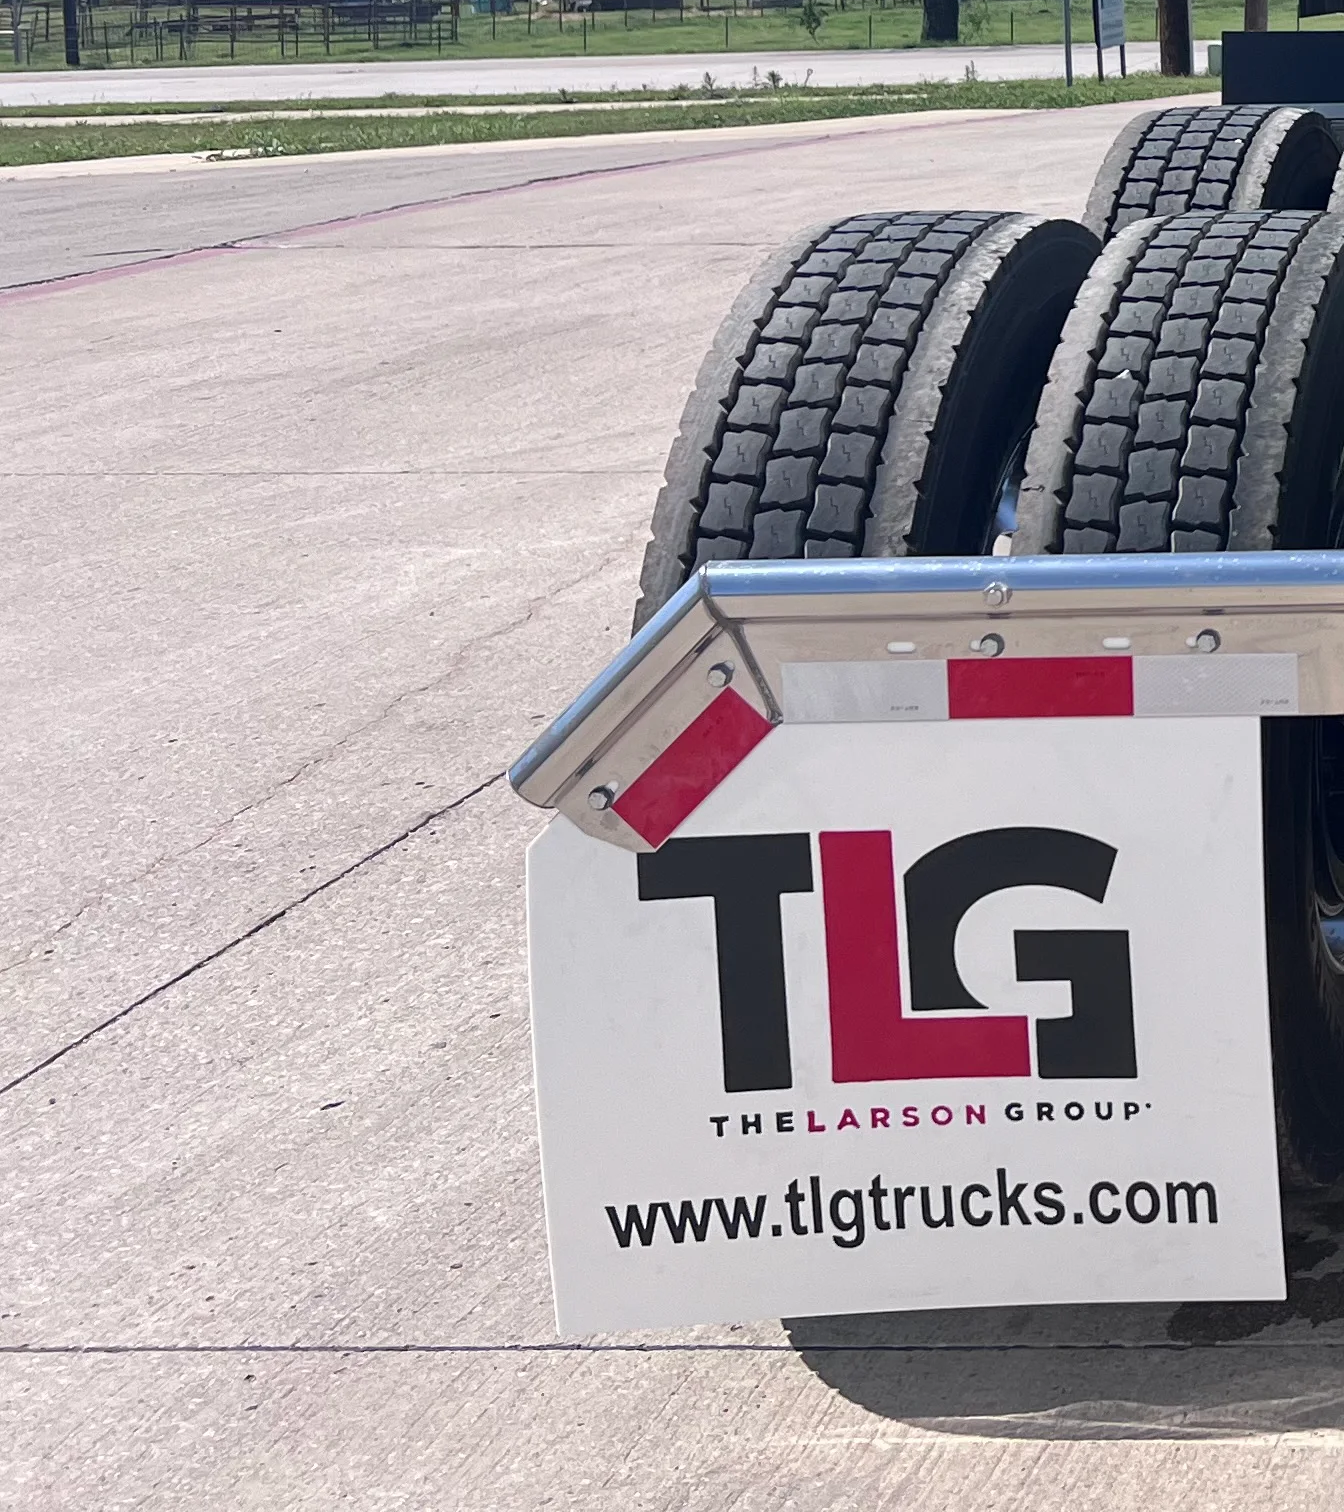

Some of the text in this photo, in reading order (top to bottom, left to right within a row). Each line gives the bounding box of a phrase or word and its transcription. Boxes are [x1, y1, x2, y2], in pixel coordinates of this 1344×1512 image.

[637, 827, 1137, 1093] TLG
[807, 1104, 986, 1133] LARSON
[1005, 1101, 1140, 1122] GROUP
[605, 1168, 1218, 1248] www.tlgtrucks.com
